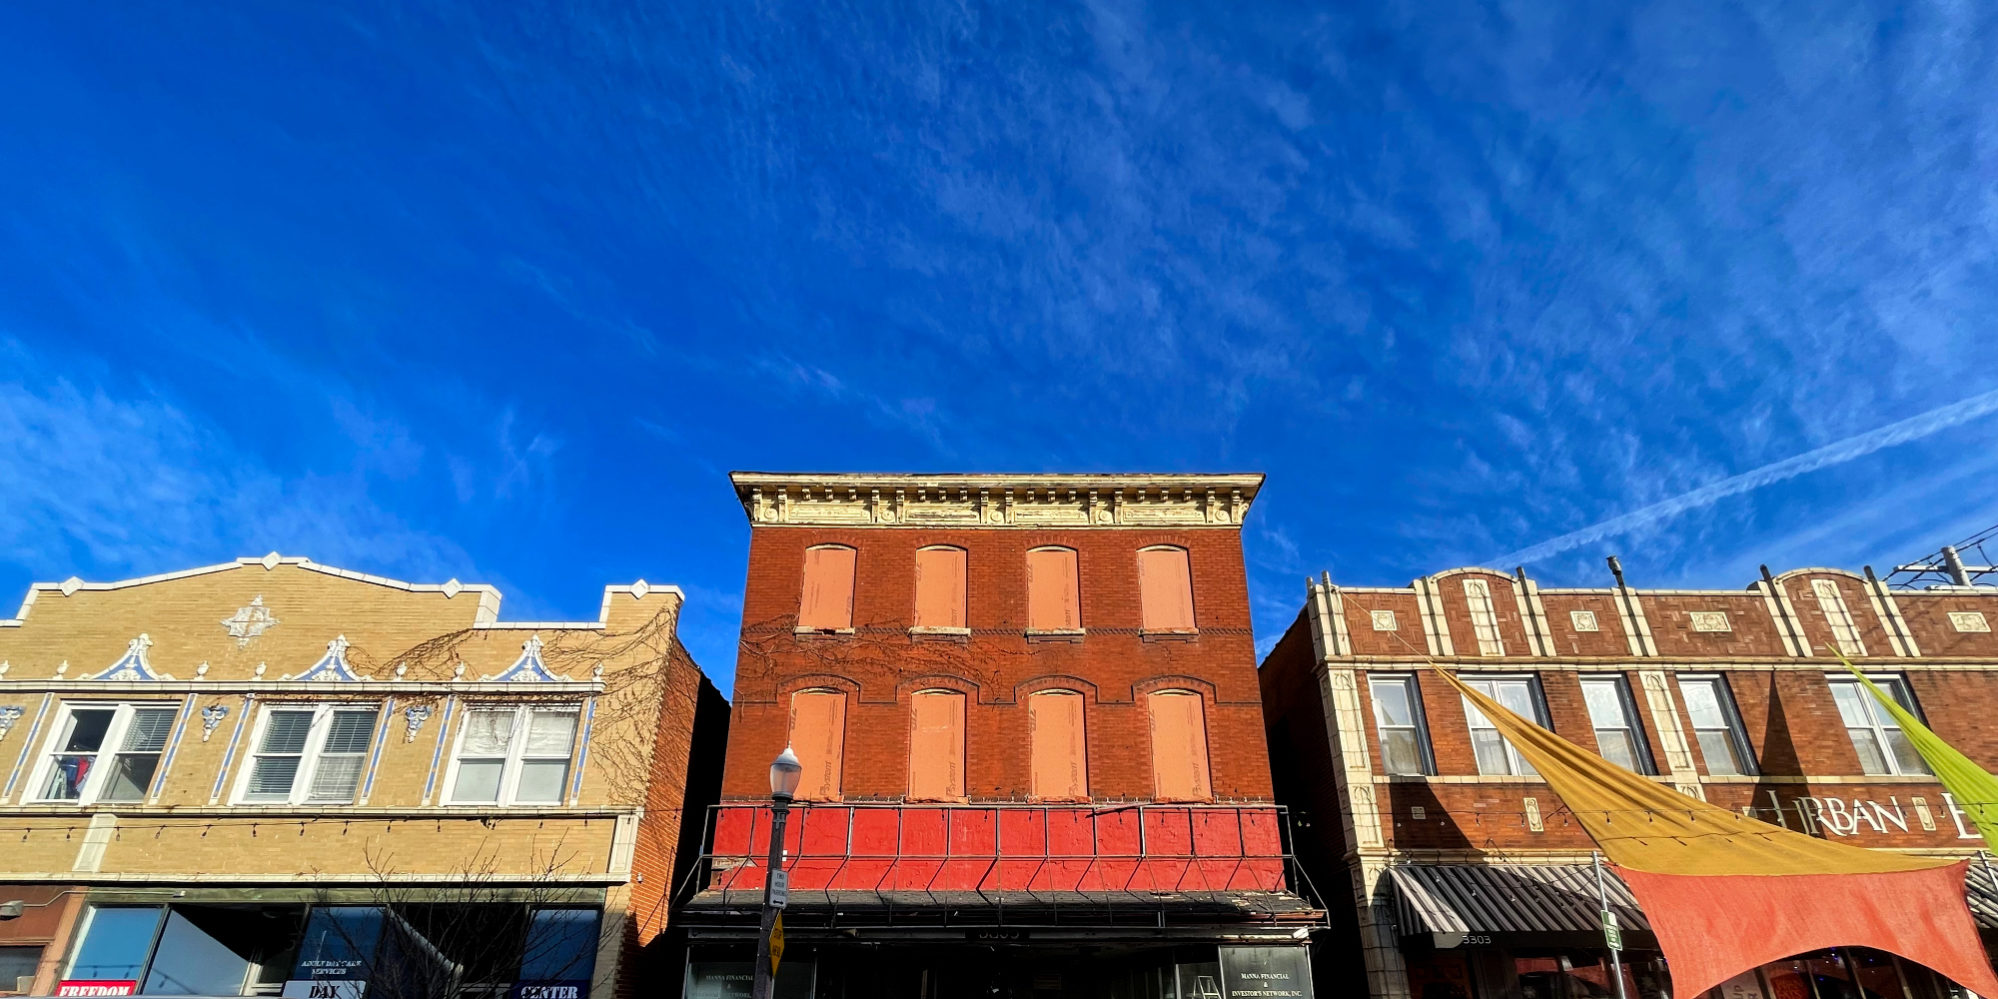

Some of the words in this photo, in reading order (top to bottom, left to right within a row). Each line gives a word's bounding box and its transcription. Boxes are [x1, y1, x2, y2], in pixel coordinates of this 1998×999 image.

[1766, 789, 1908, 837] URBAN
[1461, 935, 1492, 944] 3303
[59, 985, 131, 997] FREEDOM
[308, 985, 341, 999] DAY
[521, 986, 578, 999] CENTER
